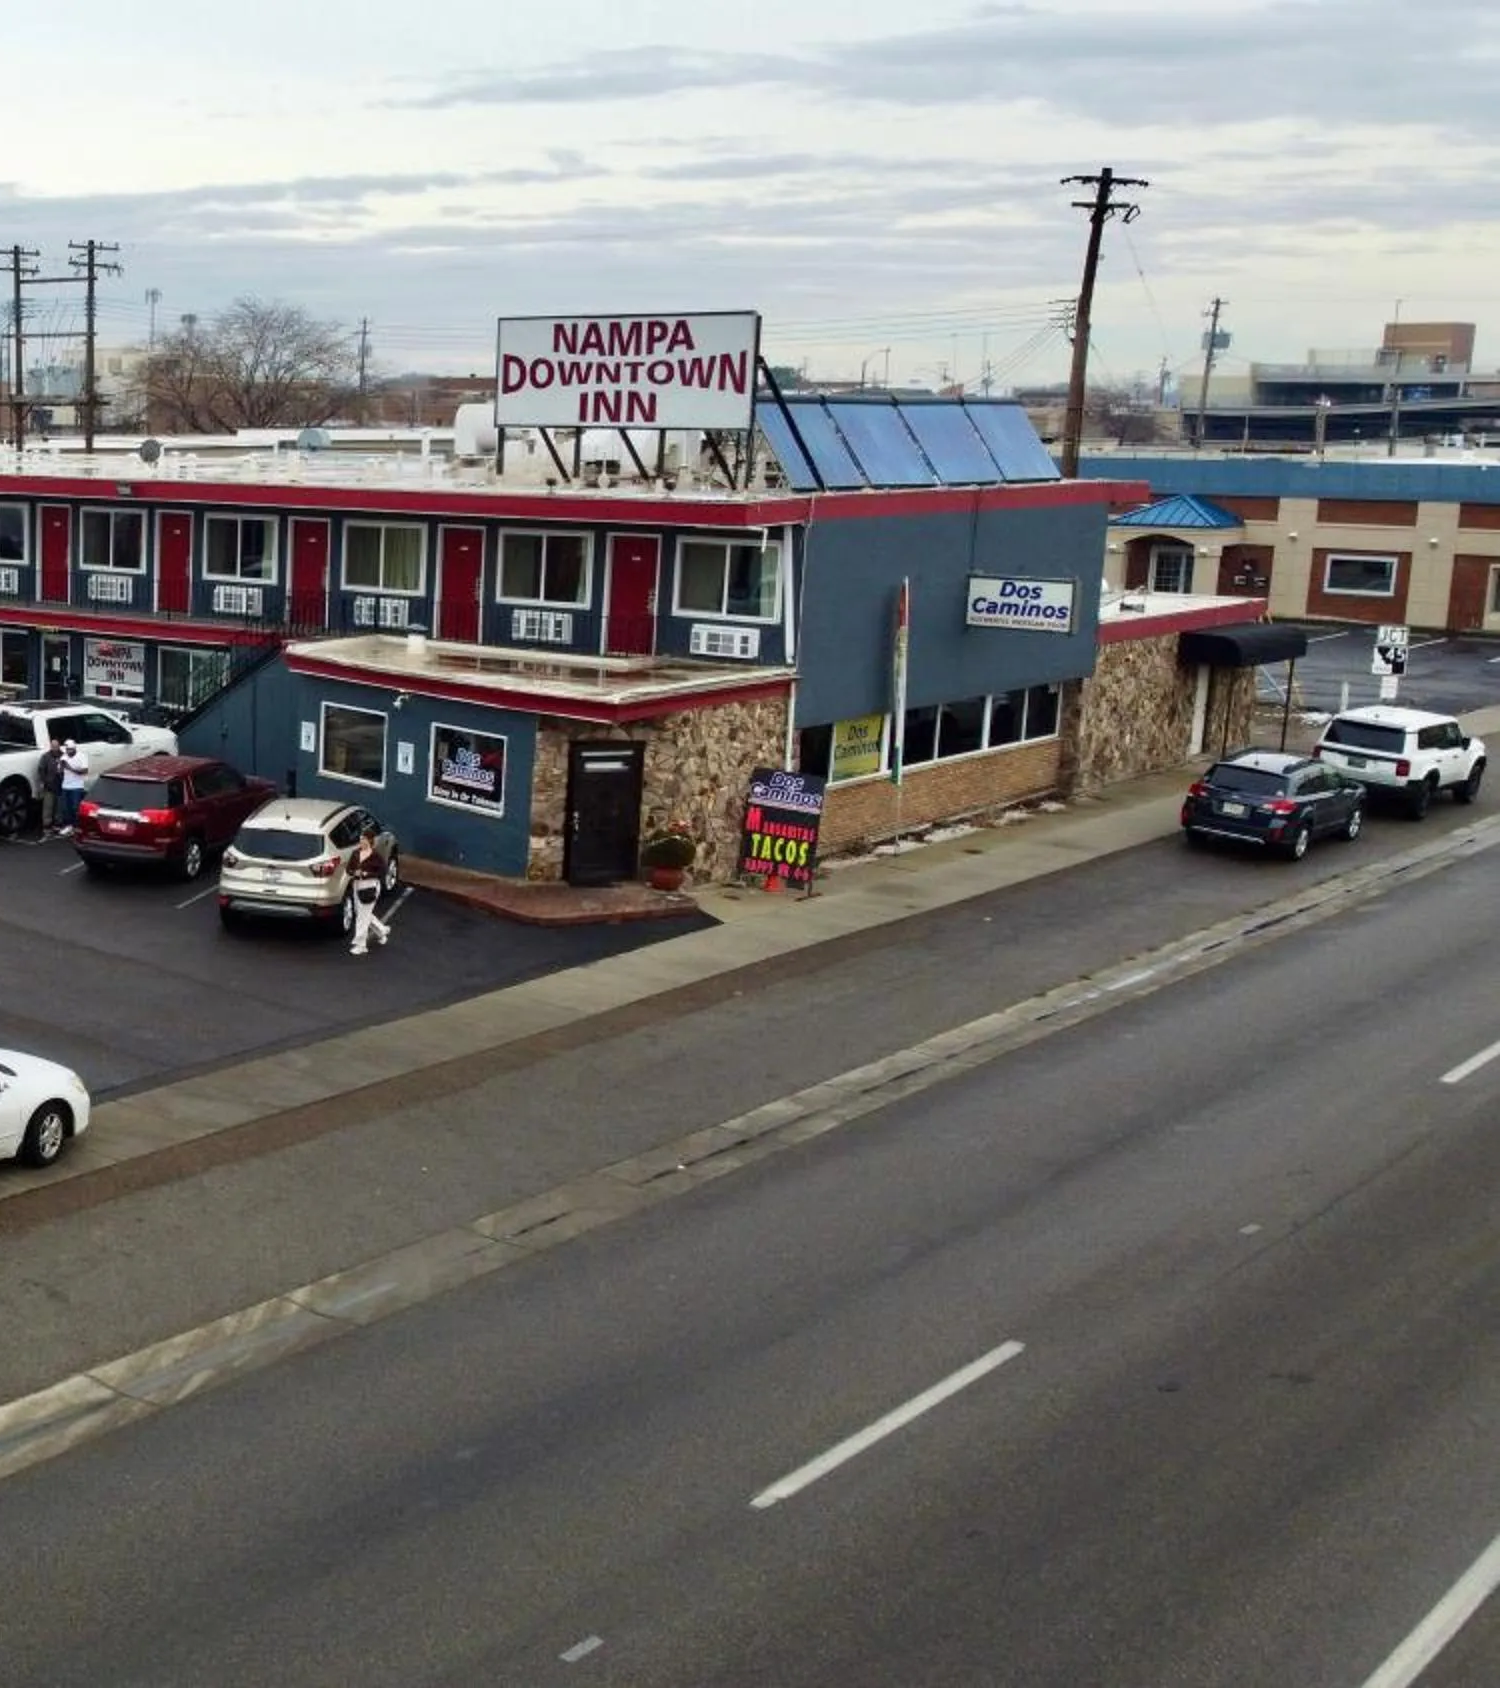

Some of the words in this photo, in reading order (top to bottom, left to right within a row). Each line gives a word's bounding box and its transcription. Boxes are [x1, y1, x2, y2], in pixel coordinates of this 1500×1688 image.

[553, 320, 695, 356] NAMPA
[502, 350, 747, 395] DOWNTOWN
[578, 390, 657, 423] INN
[1000, 582, 1042, 599] Dos
[972, 597, 1069, 619] Caminos
[752, 782, 822, 806] Caminos
[752, 833, 809, 866] TACOS
